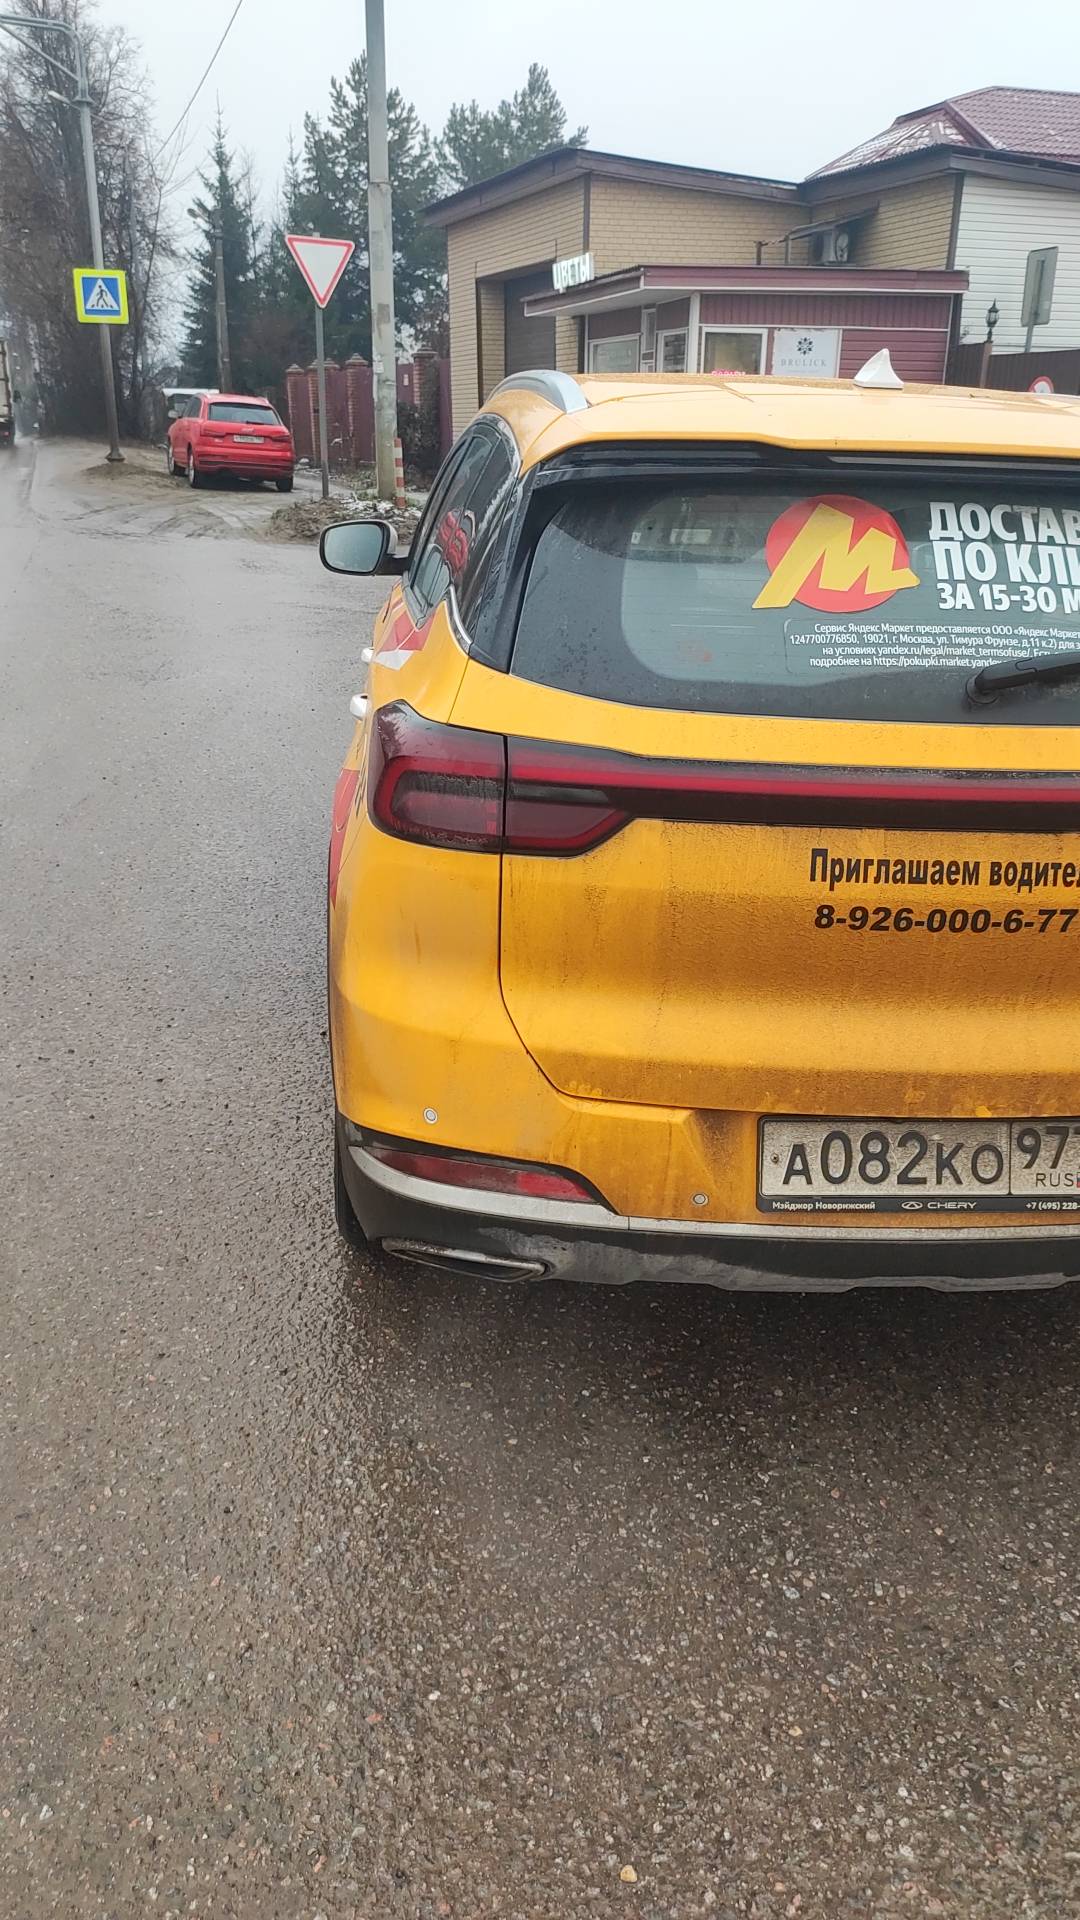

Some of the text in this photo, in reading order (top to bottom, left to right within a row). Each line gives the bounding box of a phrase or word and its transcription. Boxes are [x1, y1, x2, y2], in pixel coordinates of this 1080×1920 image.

[932, 540, 998, 582] ПО
[936, 583, 976, 610] ЗА
[978, 584, 1057, 613] 15-30
[814, 623, 847, 634] Сервис
[848, 623, 880, 634] Яндекс
[881, 623, 914, 635] Маркет
[916, 624, 991, 635] предоставляется
[992, 625, 1012, 635] ООО
[1014, 626, 1049, 637] «Яндекс
[936, 636, 949, 646] ул.
[950, 635, 984, 647] Тимура
[1058, 641, 1075, 650] для
[822, 647, 833, 655] на
[834, 647, 876, 656] условиях
[810, 656, 860, 668] подробнее
[861, 657, 872, 666] на
[809, 847, 1080, 894] Приглашаем водите
[814, 904, 1079, 934] 8-926-000-6-77
[1016, 1126, 1080, 1170] 97
[1035, 1172, 1074, 1187] RUS
[772, 1200, 876, 1210] Мэйджор Новорижский
[927, 1202, 977, 1210] CHERY
[1025, 1201, 1037, 1210] +7
[1038, 1201, 1061, 1211] (495)
